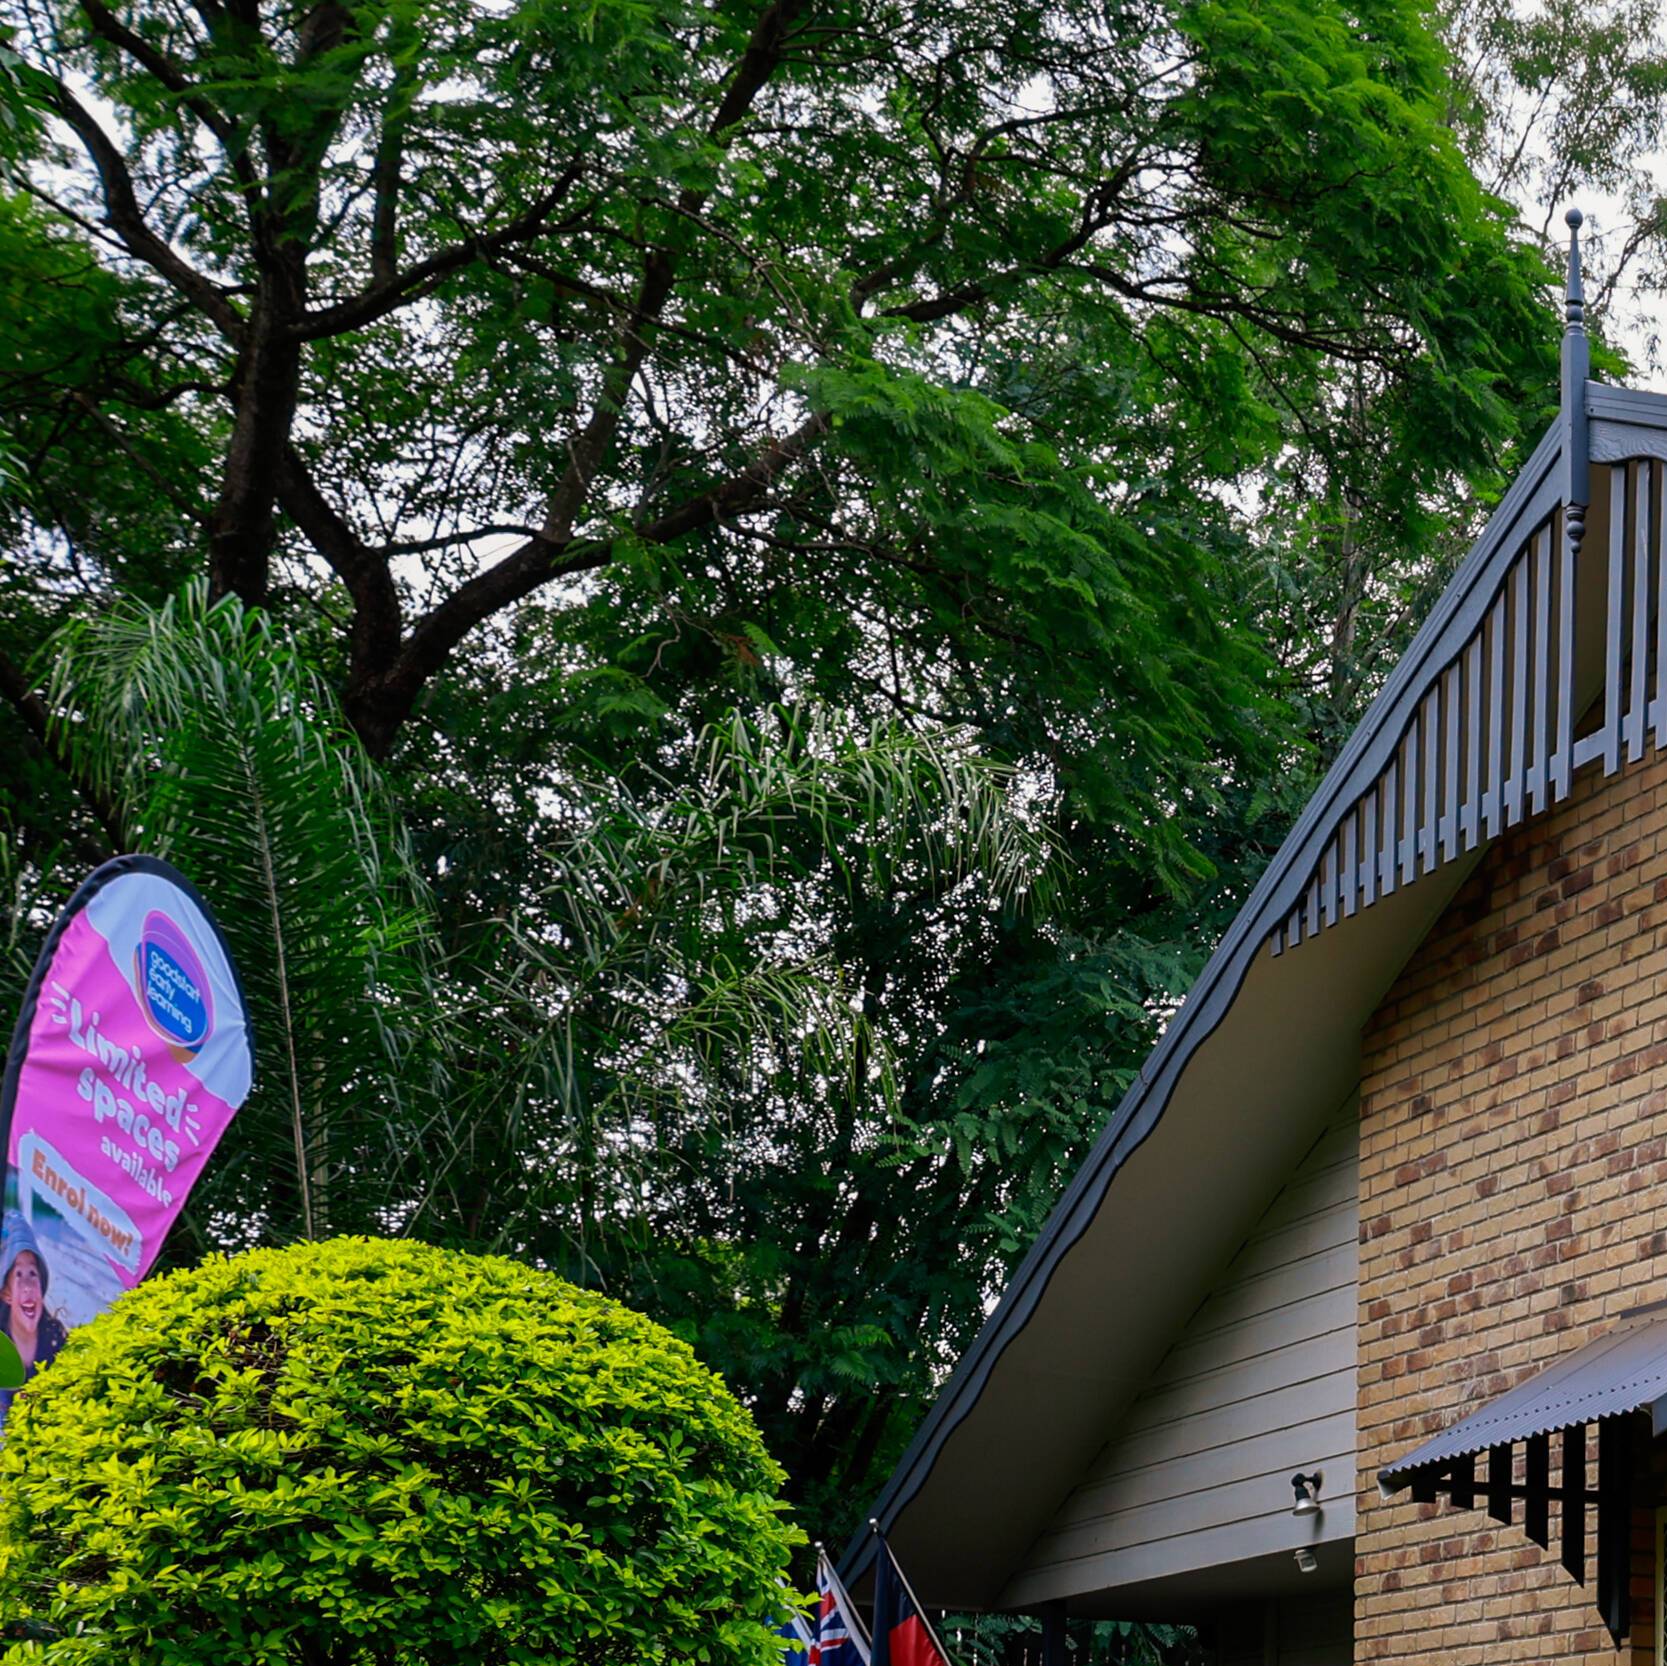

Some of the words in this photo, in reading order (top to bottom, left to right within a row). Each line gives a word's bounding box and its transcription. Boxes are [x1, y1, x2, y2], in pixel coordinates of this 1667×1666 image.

[147, 980, 193, 1034] learning
[149, 967, 176, 1001] early
[150, 951, 201, 1004] goodstart
[69, 998, 188, 1133] Limited
[76, 1067, 181, 1172] spaces
[31, 1147, 87, 1217] Enrol
[86, 1208, 134, 1258] now!
[101, 1136, 173, 1208] available
